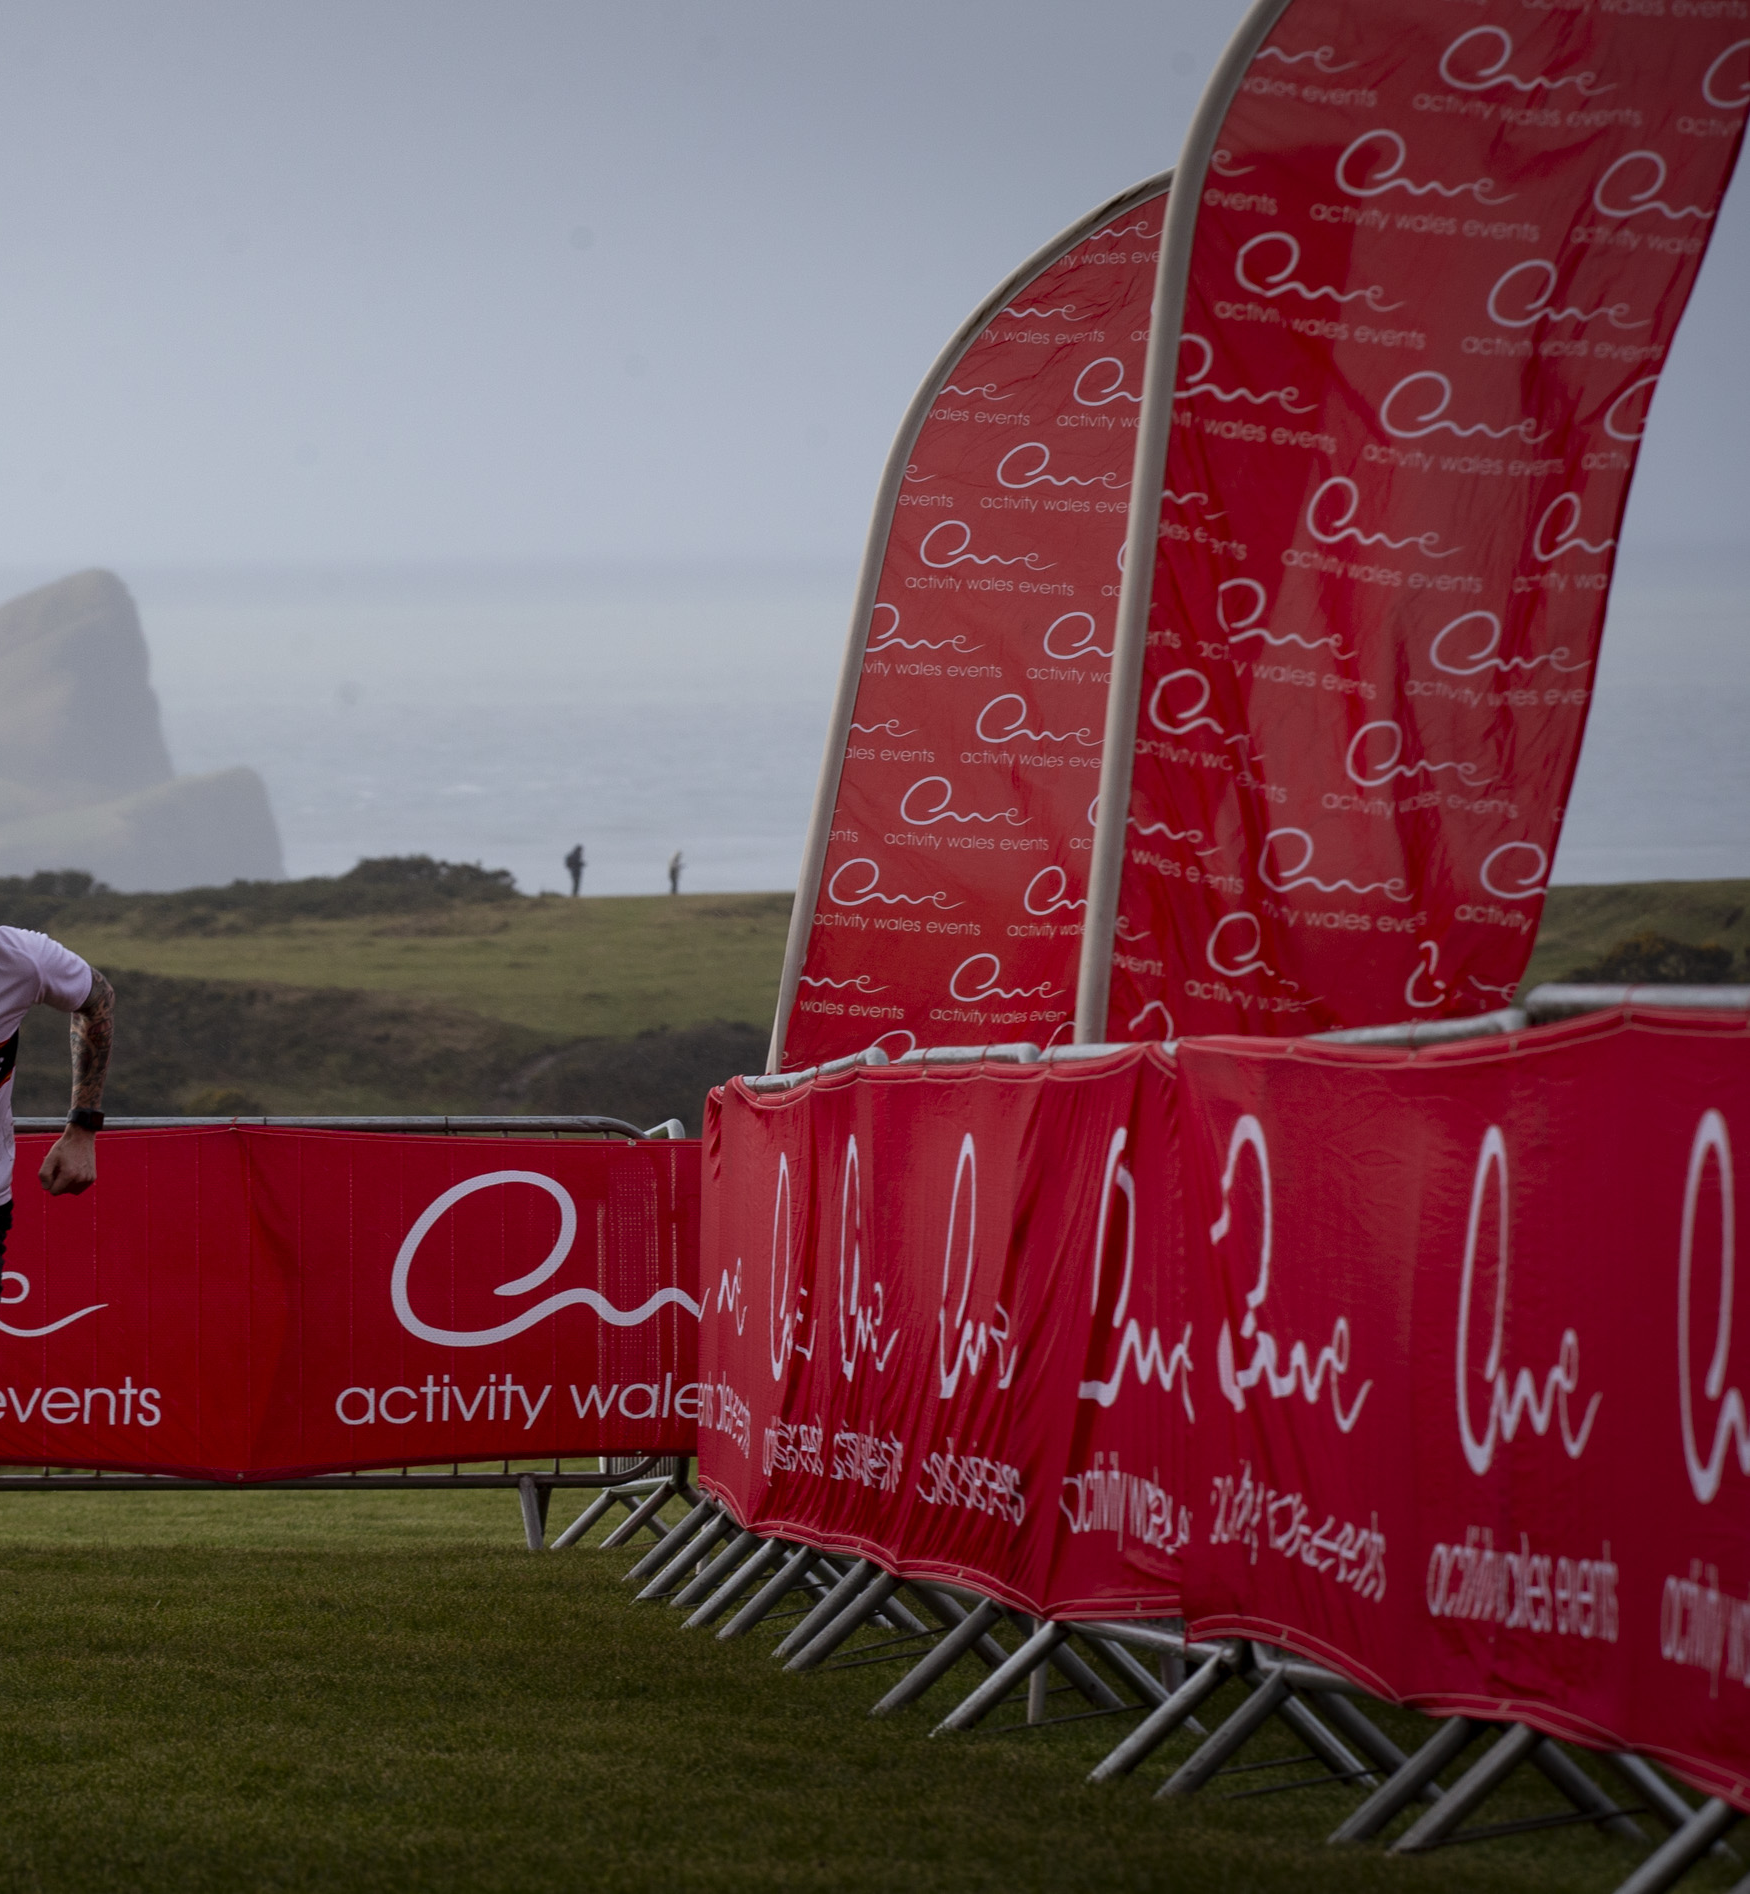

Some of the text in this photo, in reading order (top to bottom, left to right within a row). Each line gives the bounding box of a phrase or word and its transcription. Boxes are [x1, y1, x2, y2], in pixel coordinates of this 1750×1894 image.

[1302, 83, 1378, 108] events
[1412, 91, 1642, 129] activity wales events
[1204, 187, 1278, 216] events
[1309, 201, 1541, 243] activity wales events
[1570, 226, 1643, 251] activity
[1082, 251, 1126, 265] wales
[1132, 250, 1161, 264] eve
[1004, 329, 1050, 344] wales
[1289, 318, 1426, 352] wales events
[975, 412, 1030, 426] events
[1056, 414, 1116, 430] activity
[1203, 417, 1267, 444] wales
[1271, 426, 1337, 454] events
[1362, 442, 1436, 473] activity
[1441, 451, 1503, 476] wales
[899, 493, 954, 508] events
[980, 496, 1130, 514] activity wales eve
[905, 576, 1074, 596] activity wales events
[1352, 563, 1403, 587] wales
[1408, 572, 1483, 594] events
[896, 662, 1002, 679] wales events
[1026, 666, 1086, 684] activity
[1252, 664, 1317, 688] wales
[1405, 679, 1482, 708] activity
[880, 749, 935, 763] events
[960, 750, 1102, 768] activity wales eve
[1321, 791, 1395, 817] activity
[884, 833, 1049, 851] activity wales events
[812, 913, 981, 936] activity wales events
[1007, 923, 1086, 938] activity wale
[1304, 909, 1371, 932] wales
[1454, 903, 1533, 935] activity
[800, 1000, 904, 1020] wales events
[929, 1007, 1027, 1026] activity wales
[335, 1373, 552, 1431] activity
